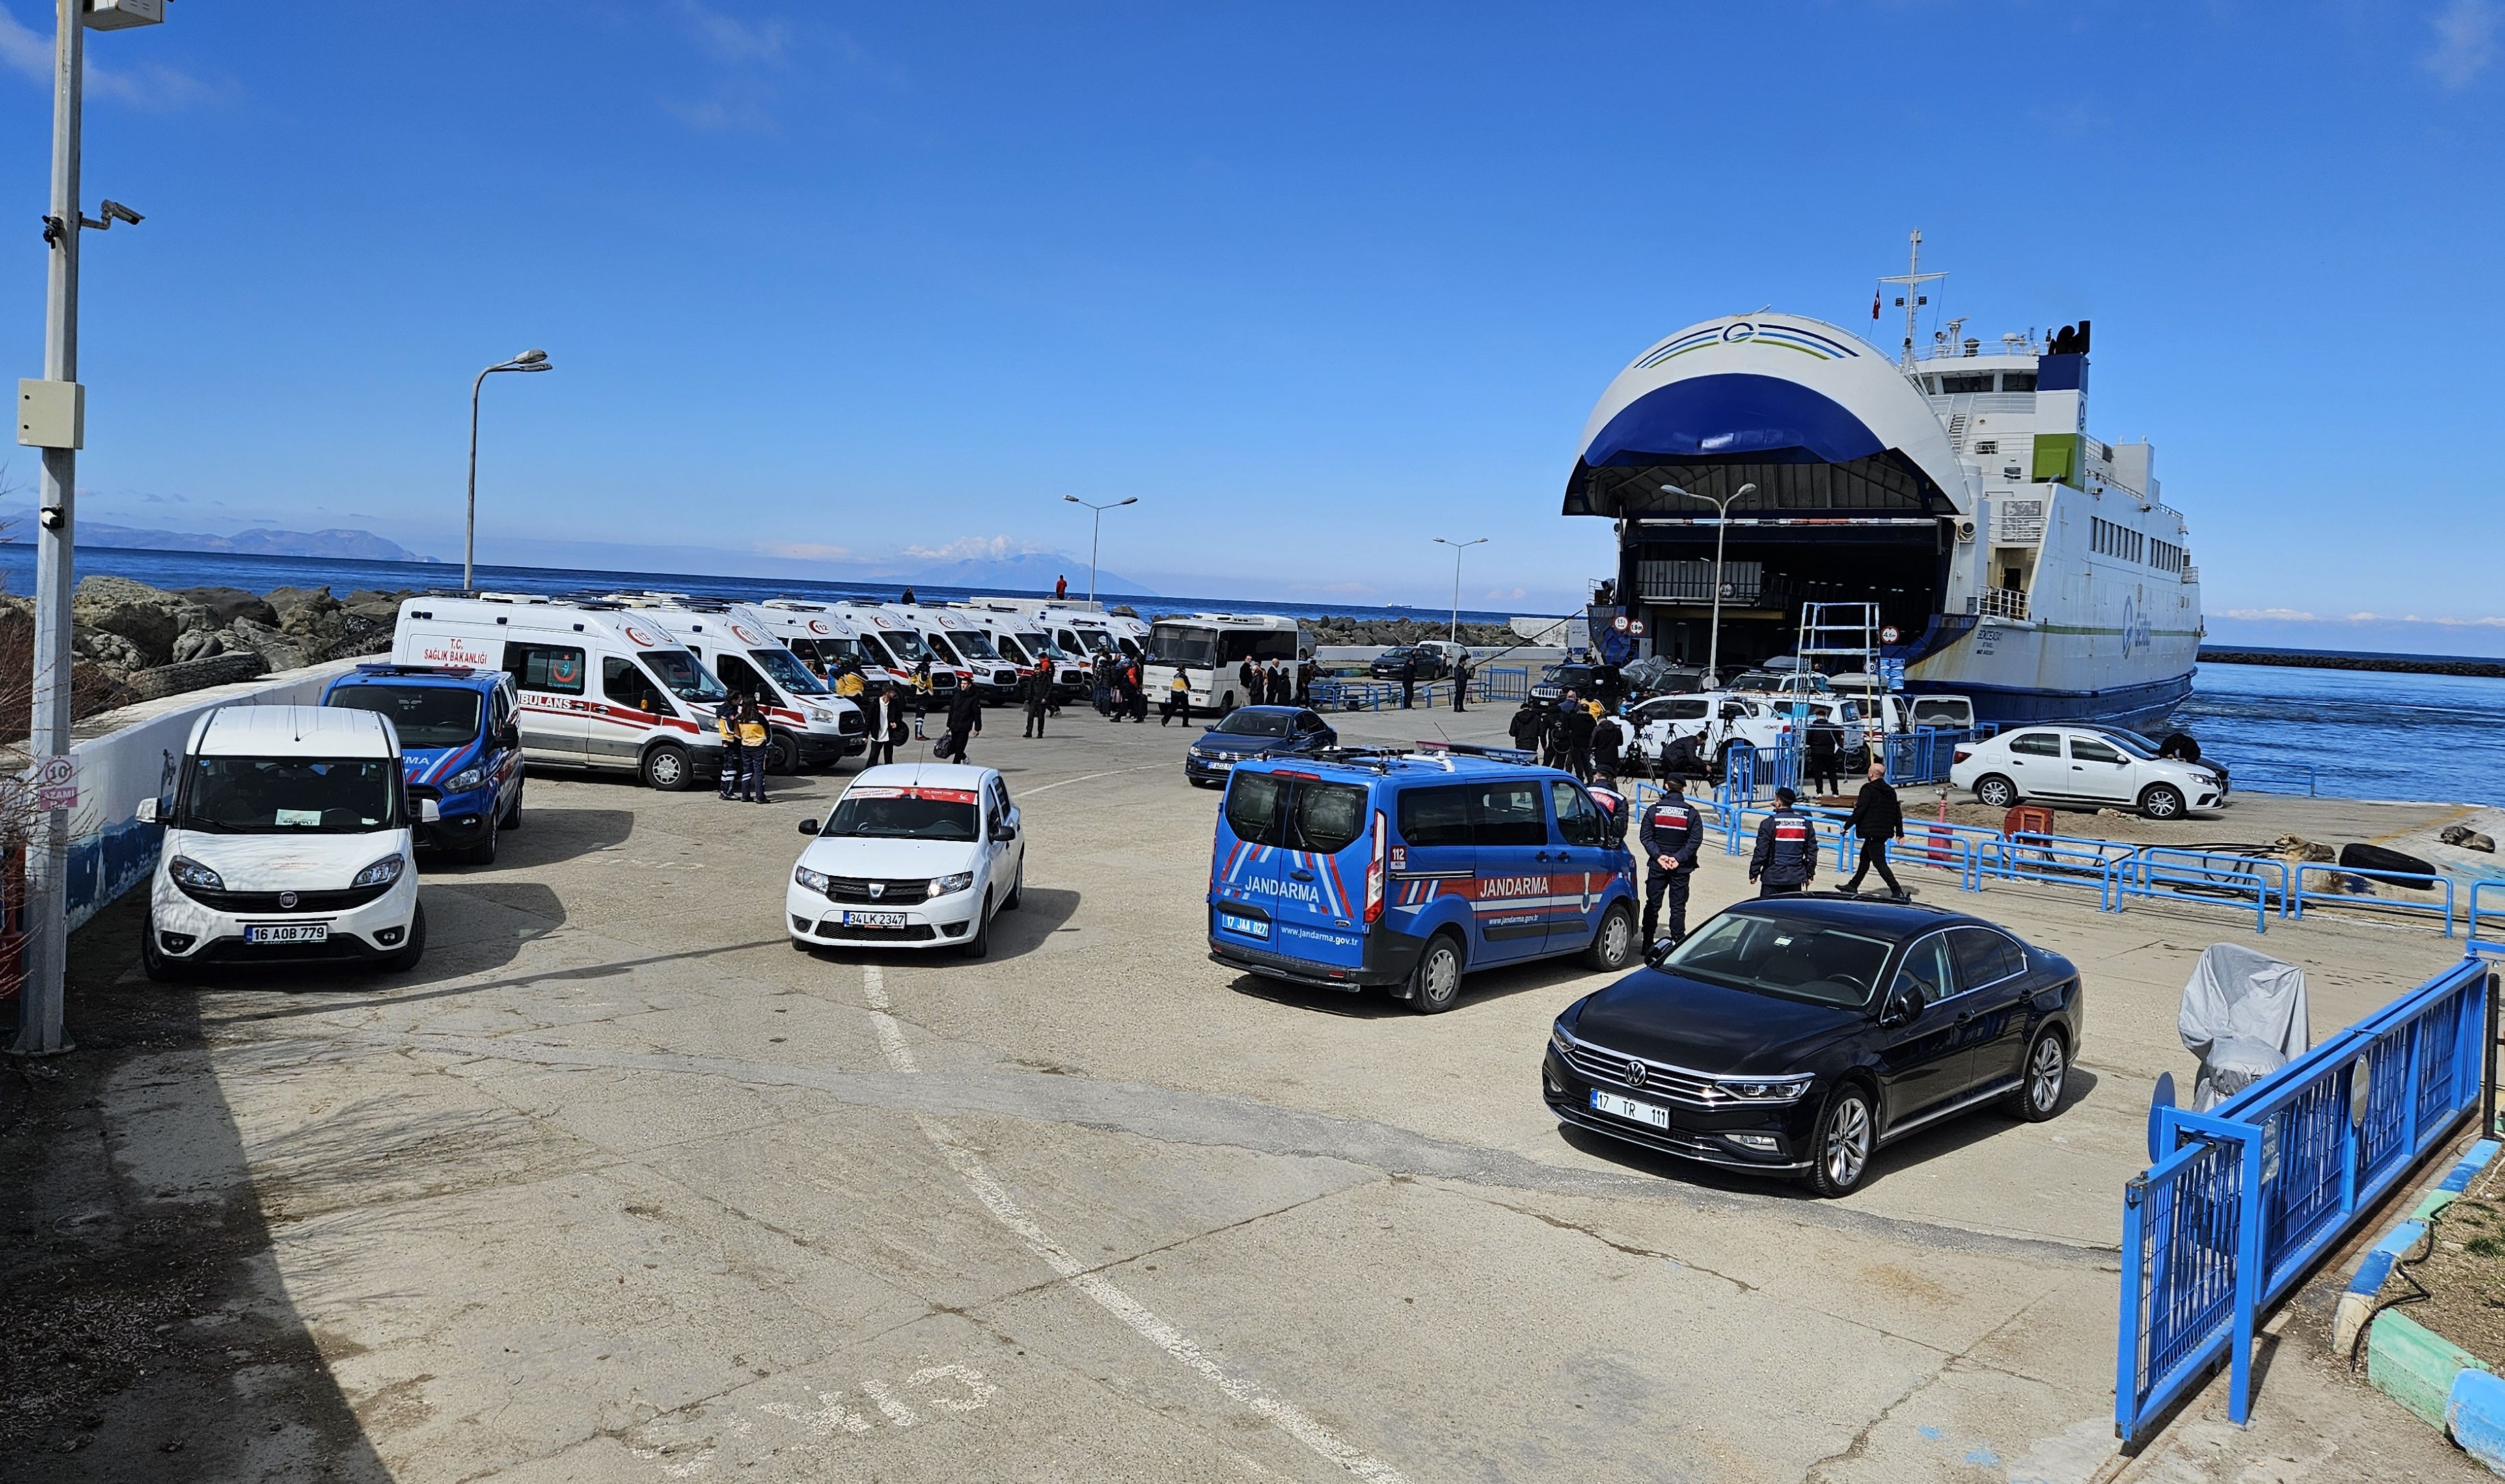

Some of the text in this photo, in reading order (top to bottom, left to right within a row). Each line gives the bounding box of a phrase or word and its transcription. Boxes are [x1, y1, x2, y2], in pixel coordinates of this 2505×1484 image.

[451, 638, 463, 650] T.C.
[424, 648, 487, 665] SAĞLIK BAKANLIĞI
[520, 693, 571, 709] BULANS
[50, 766, 68, 779] 10
[1392, 848, 1405, 861] 112
[1245, 875, 1319, 903] JANDARMA
[1480, 877, 1549, 898] JANDARMA
[850, 913, 904, 925] 34 LK 2347
[1227, 918, 1266, 935] 17 JAA 027
[255, 929, 269, 940] 16
[273, 928, 297, 939] AOB
[301, 926, 325, 939] 779
[1281, 926, 1358, 946] www.jandarma.gov.tr
[1599, 1094, 1609, 1108] 17
[1623, 1101, 1635, 1117] TR
[1652, 1109, 1666, 1125] 111
